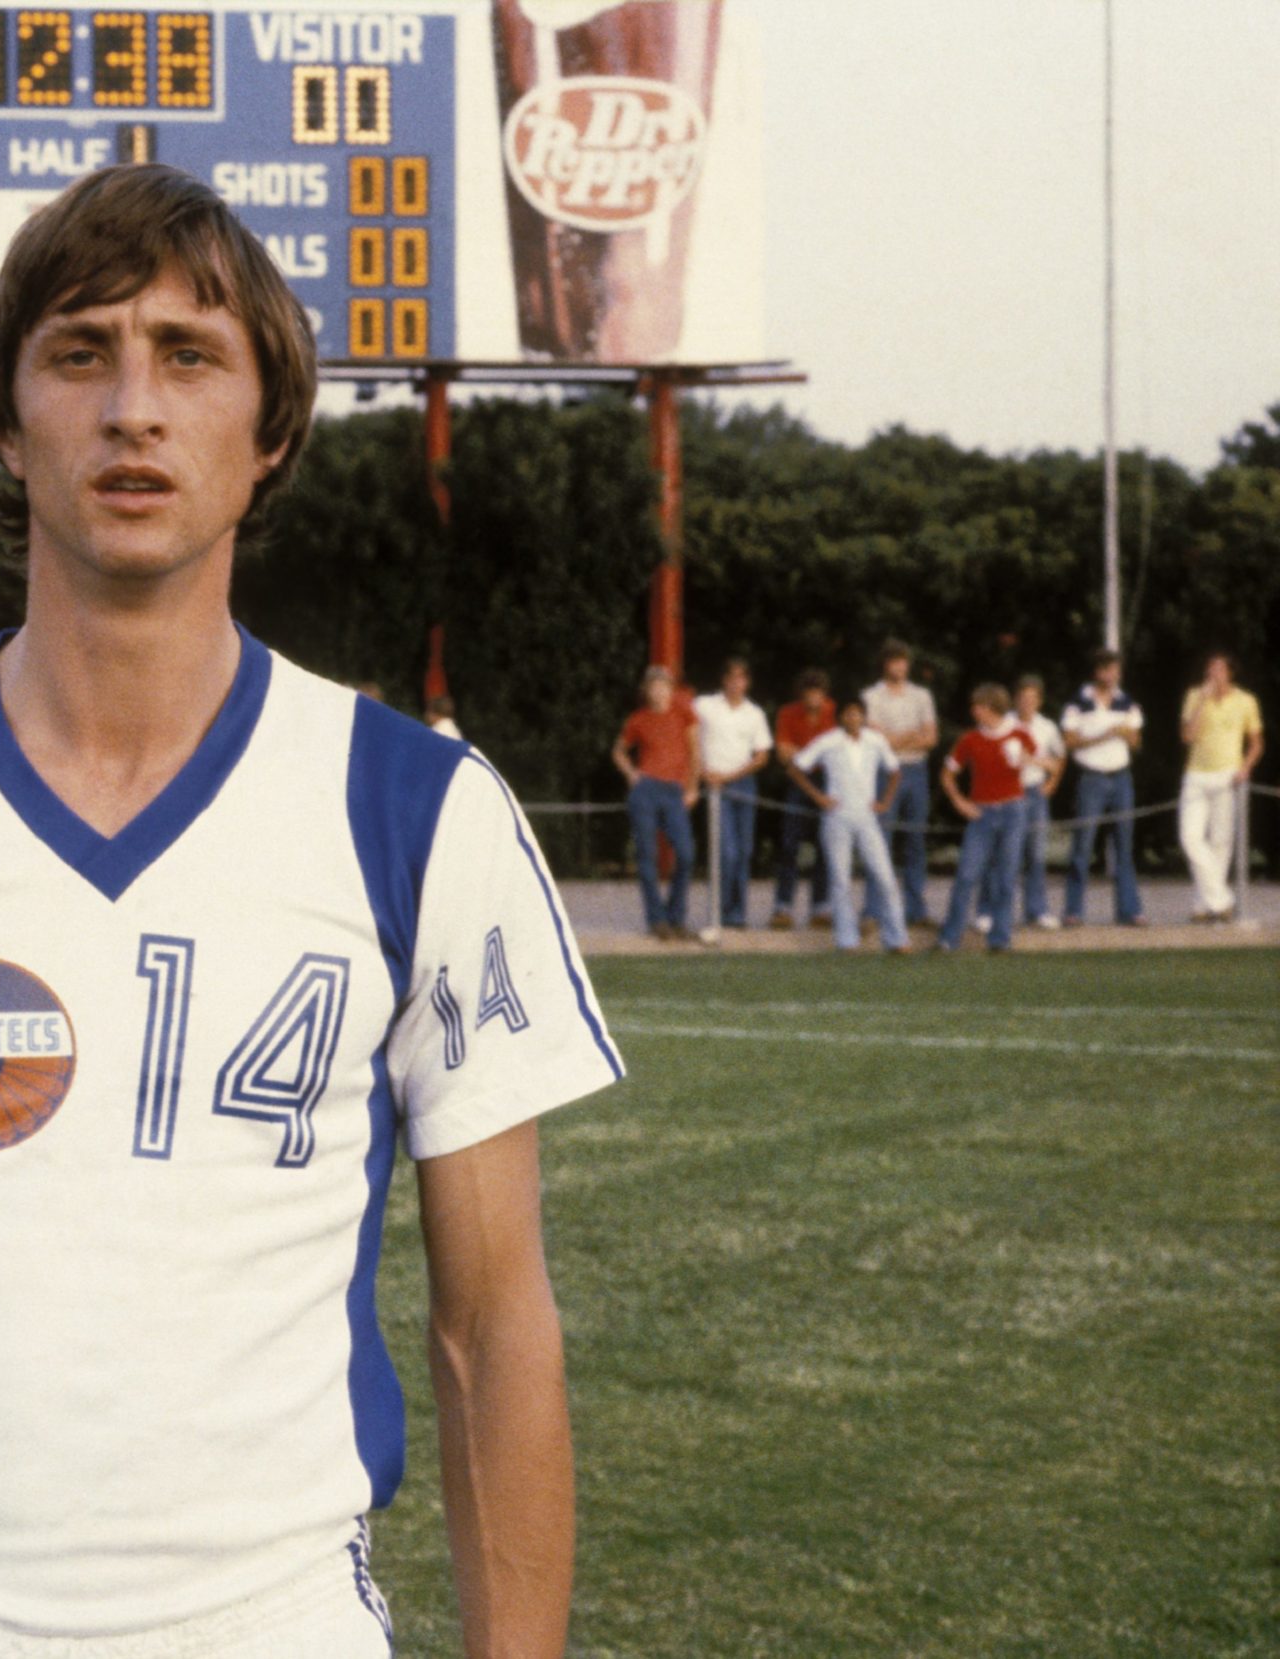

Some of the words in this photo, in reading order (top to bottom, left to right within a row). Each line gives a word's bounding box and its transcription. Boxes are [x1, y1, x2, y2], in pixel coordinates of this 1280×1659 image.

[249, 12, 424, 64] VISITOR
[292, 66, 391, 145] 00
[212, 162, 329, 207] SHOTS
[349, 156, 428, 217] 00
[519, 110, 706, 207] Pepper
[349, 227, 428, 287] 00
[349, 298, 428, 358] 00
[431, 924, 530, 1070] 14
[131, 932, 352, 1169] 14
